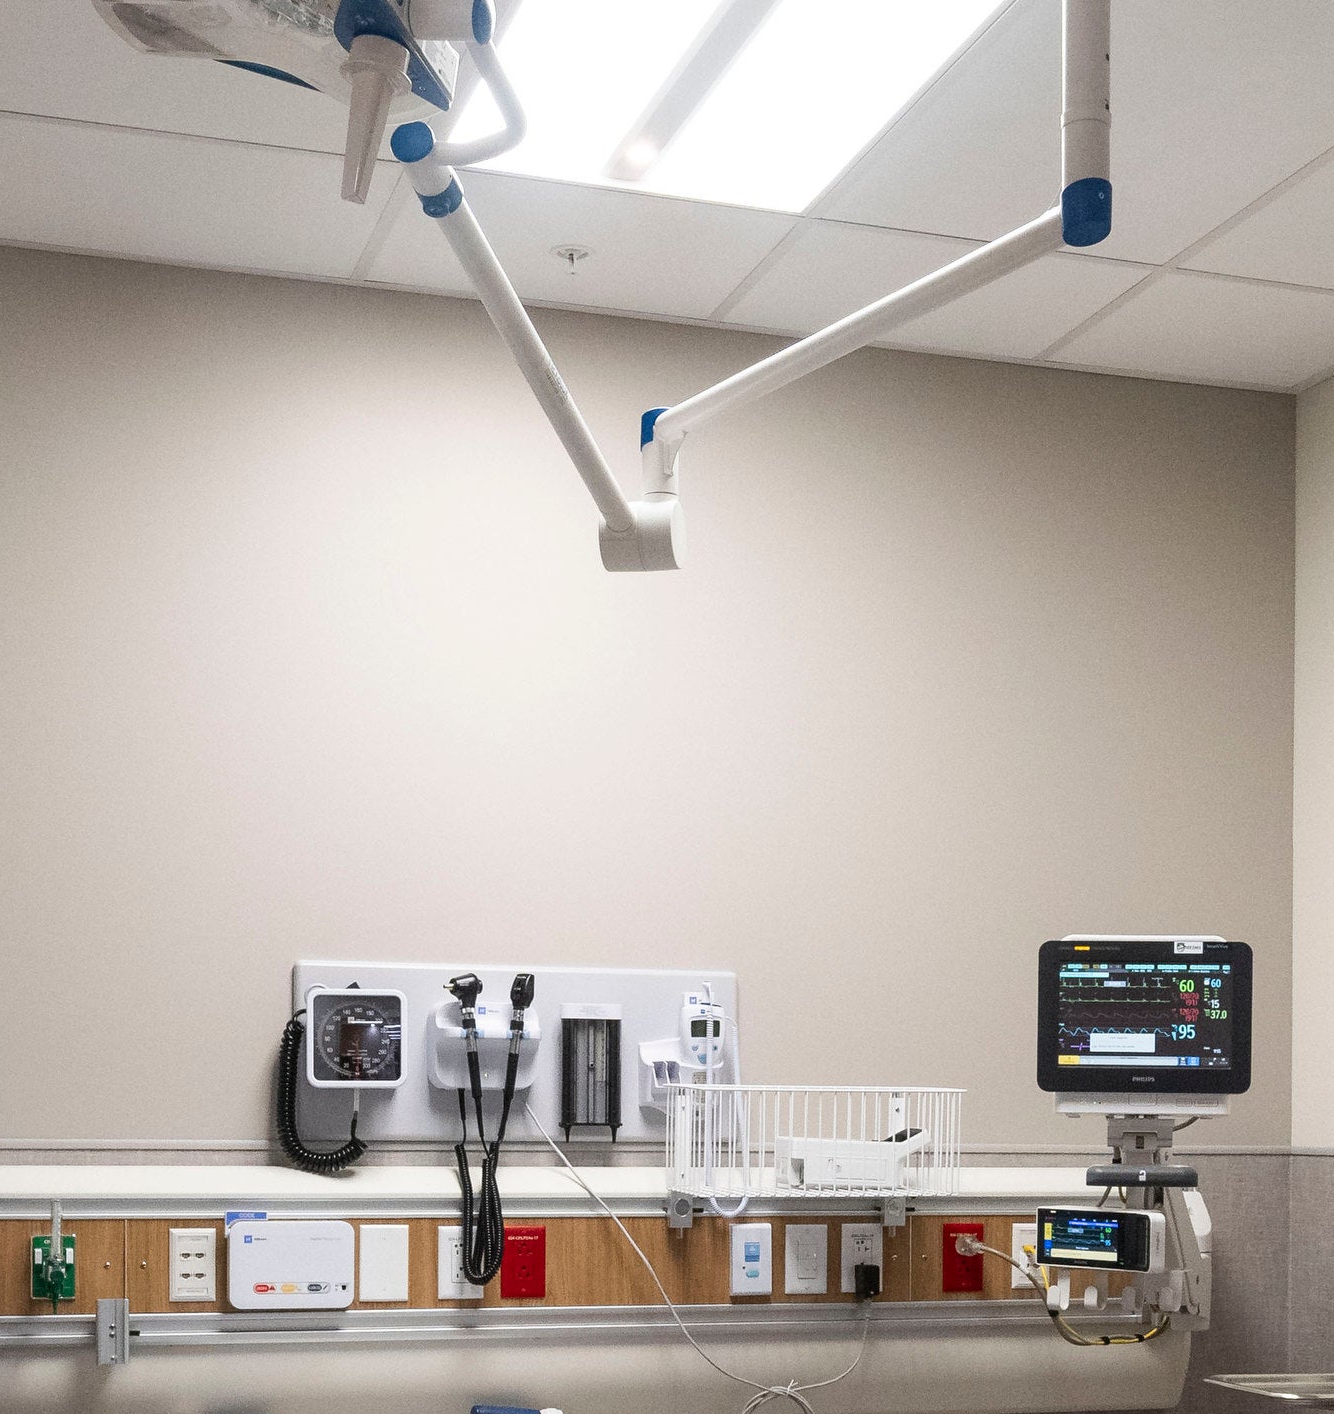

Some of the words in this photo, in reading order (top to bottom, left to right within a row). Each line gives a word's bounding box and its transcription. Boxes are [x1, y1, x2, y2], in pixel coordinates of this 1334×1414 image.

[1179, 979, 1195, 993] 60
[1210, 978, 1222, 988] 60
[1211, 999, 1220, 1009] 15
[1210, 1009, 1228, 1020] 37.0
[1178, 1024, 1196, 1040] 95
